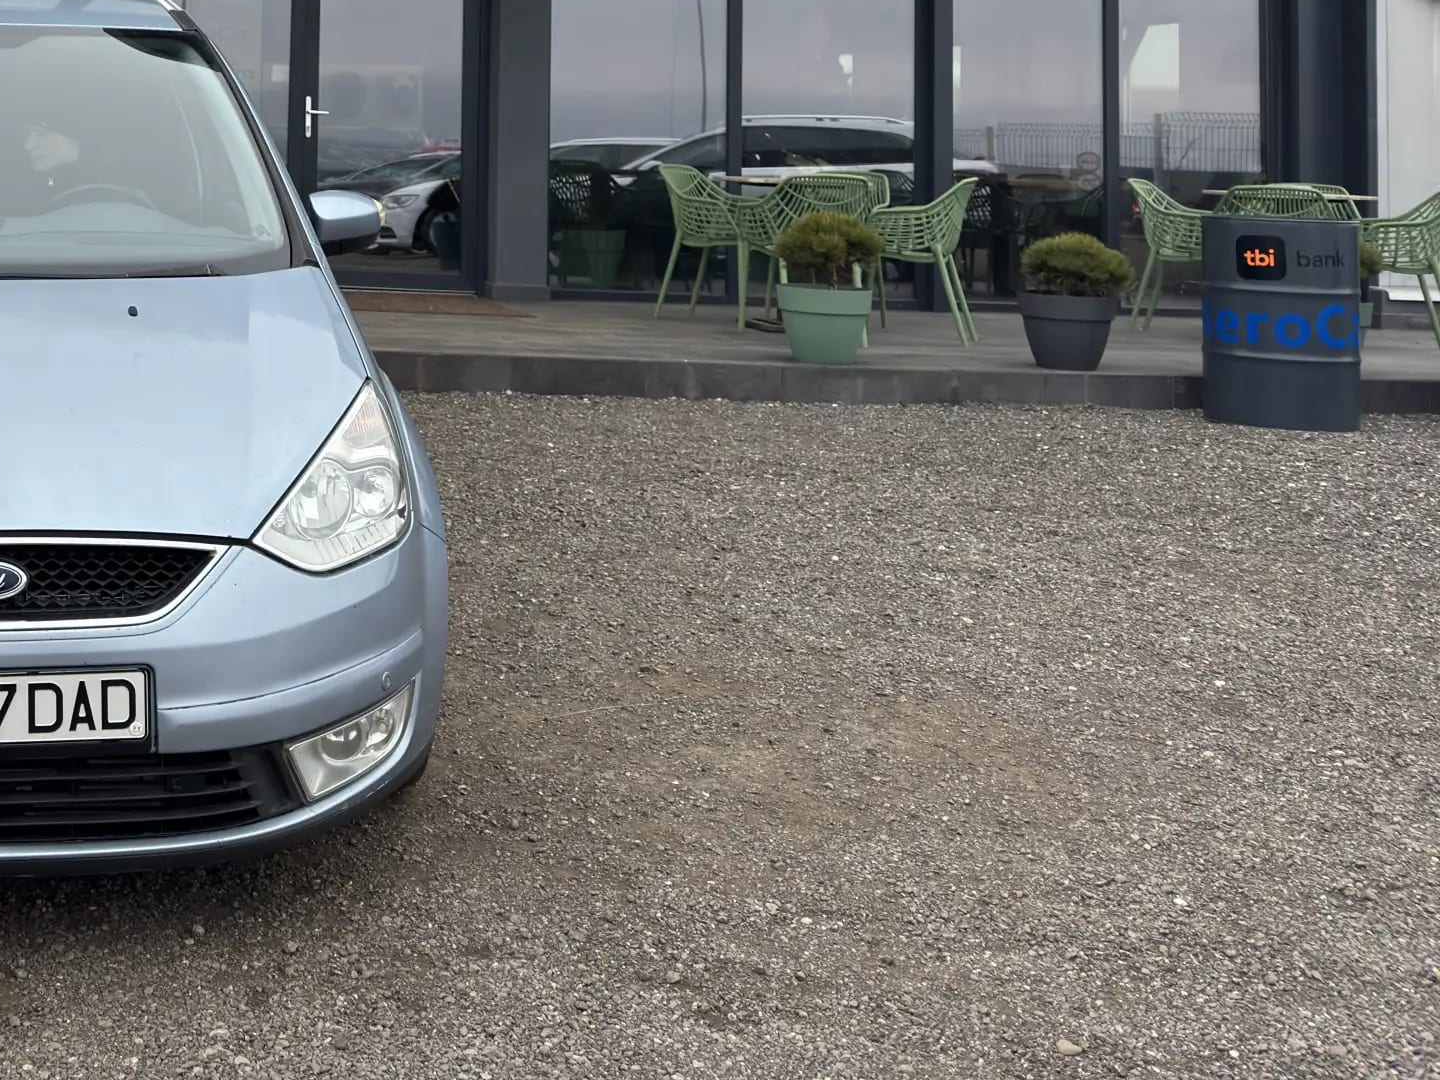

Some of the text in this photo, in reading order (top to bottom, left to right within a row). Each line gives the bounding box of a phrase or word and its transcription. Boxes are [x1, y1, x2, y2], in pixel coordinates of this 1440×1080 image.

[1243, 248, 1346, 268] tbi bank
[27, 678, 137, 733] DAD
